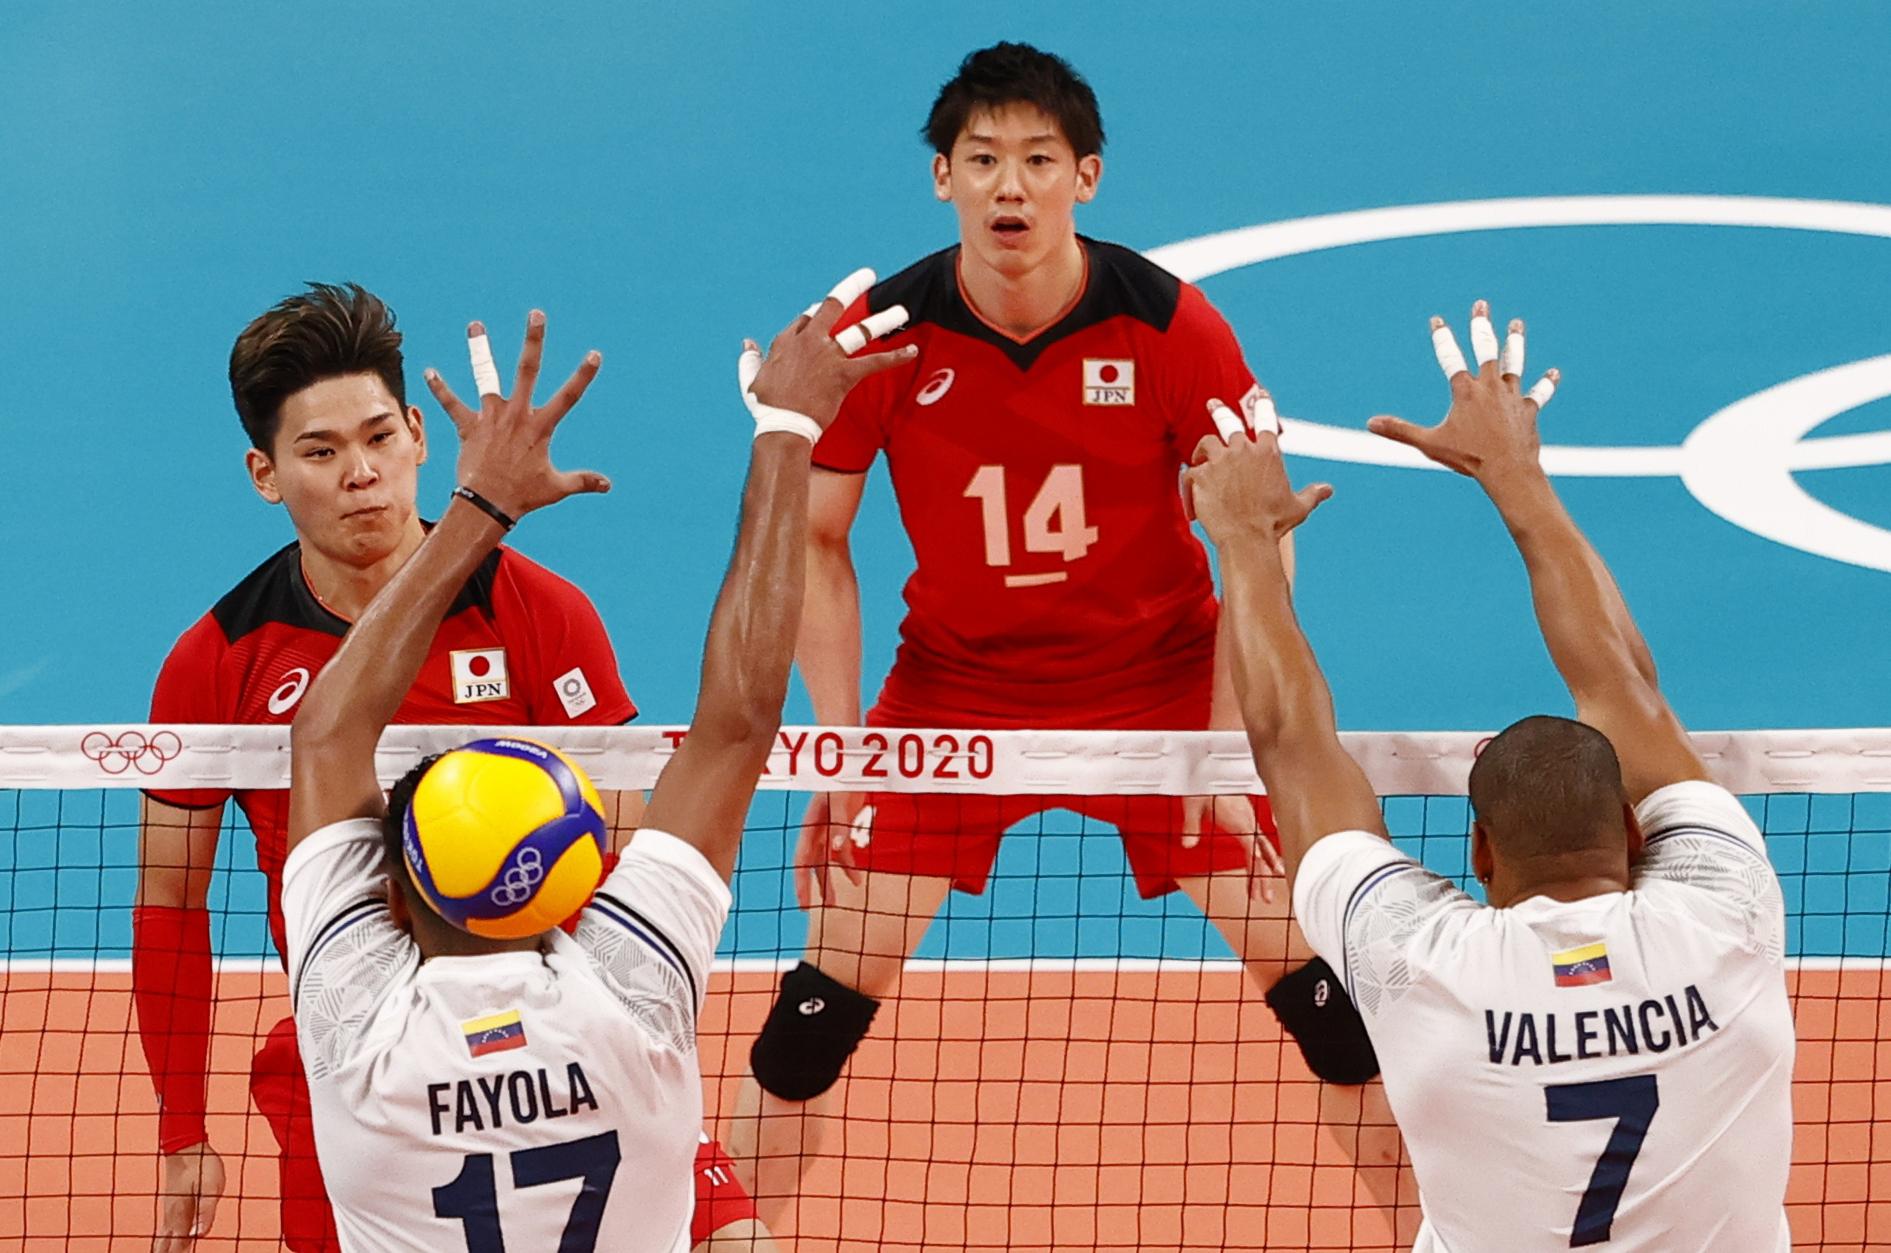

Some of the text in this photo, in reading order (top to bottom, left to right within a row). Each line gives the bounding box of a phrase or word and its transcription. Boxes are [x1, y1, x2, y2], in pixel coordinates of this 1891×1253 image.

[1092, 390, 1127, 403] JPN
[963, 464, 1099, 567] 14
[464, 683, 502, 699] JPN
[662, 731, 994, 780] TYO 2020
[1485, 984, 1719, 1066] VALENCIA
[427, 1062, 599, 1135] FAYOLA
[431, 1129, 622, 1253] 17
[1543, 1073, 1660, 1249] 7
